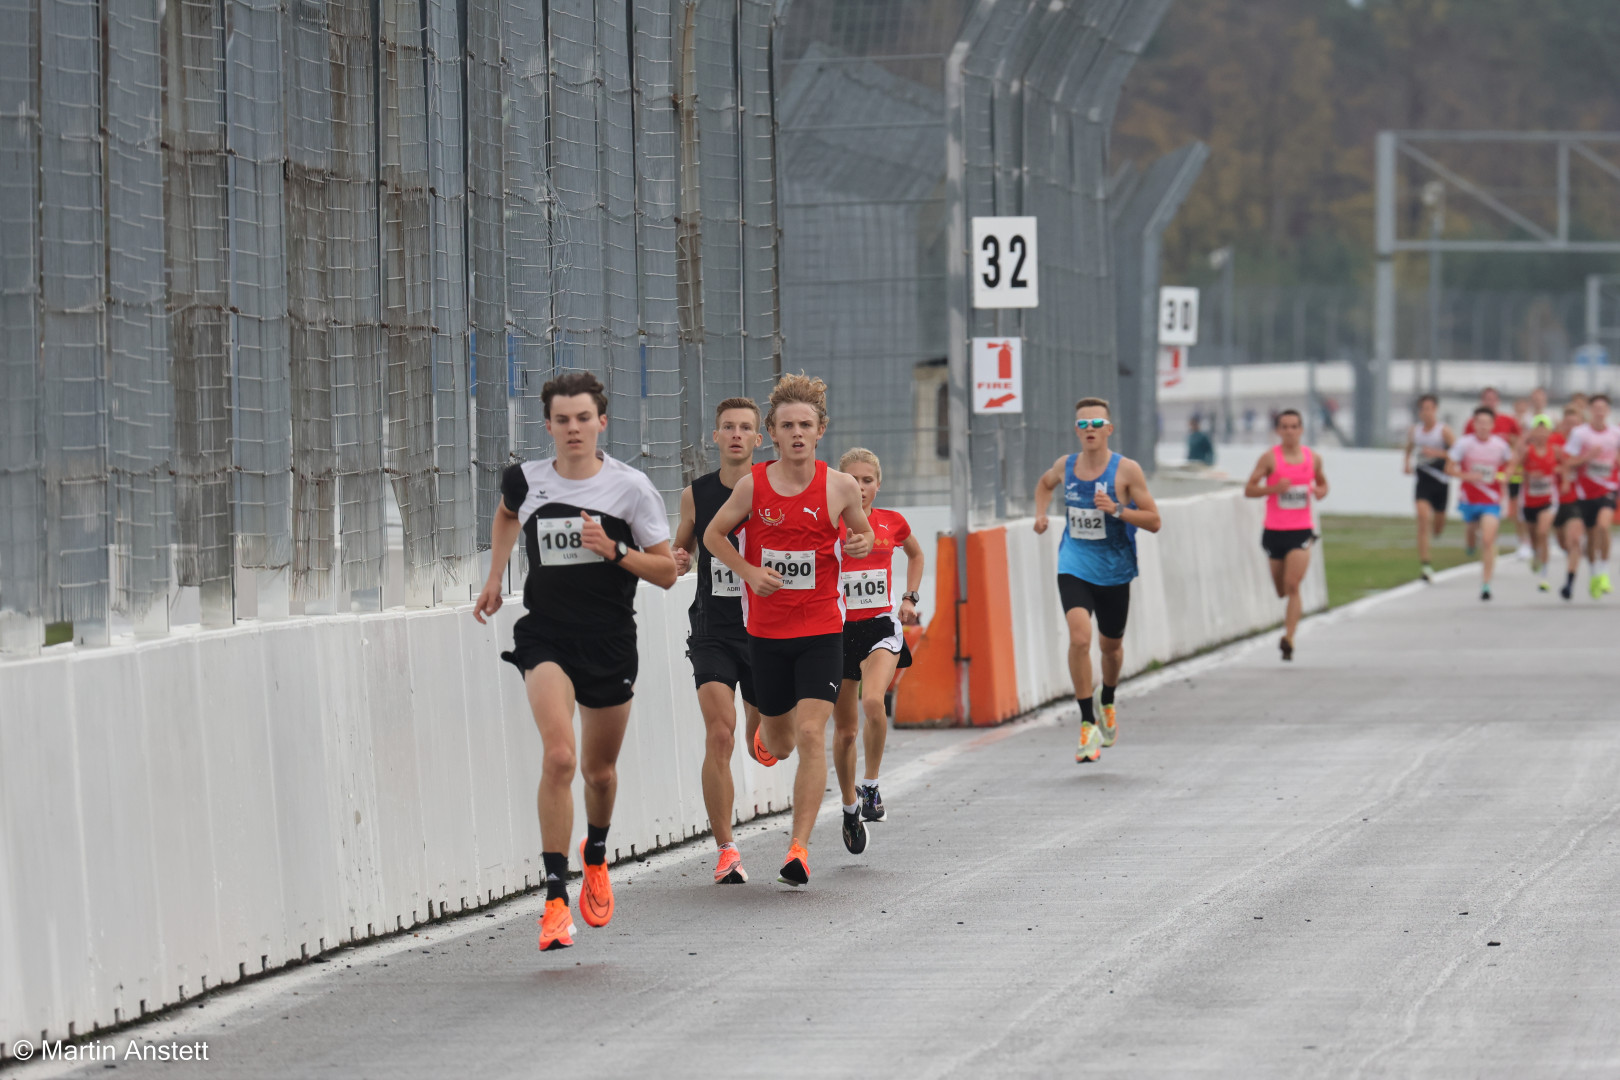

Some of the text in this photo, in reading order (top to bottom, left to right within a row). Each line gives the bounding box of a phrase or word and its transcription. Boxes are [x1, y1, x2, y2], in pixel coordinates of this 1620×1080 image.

[982, 235, 1028, 288] 32
[1165, 299, 1191, 331] 30
[977, 382, 1013, 390] FIRE
[1071, 516, 1102, 529] 1182
[764, 560, 811, 577] 1090
[843, 580, 885, 597] 1105
